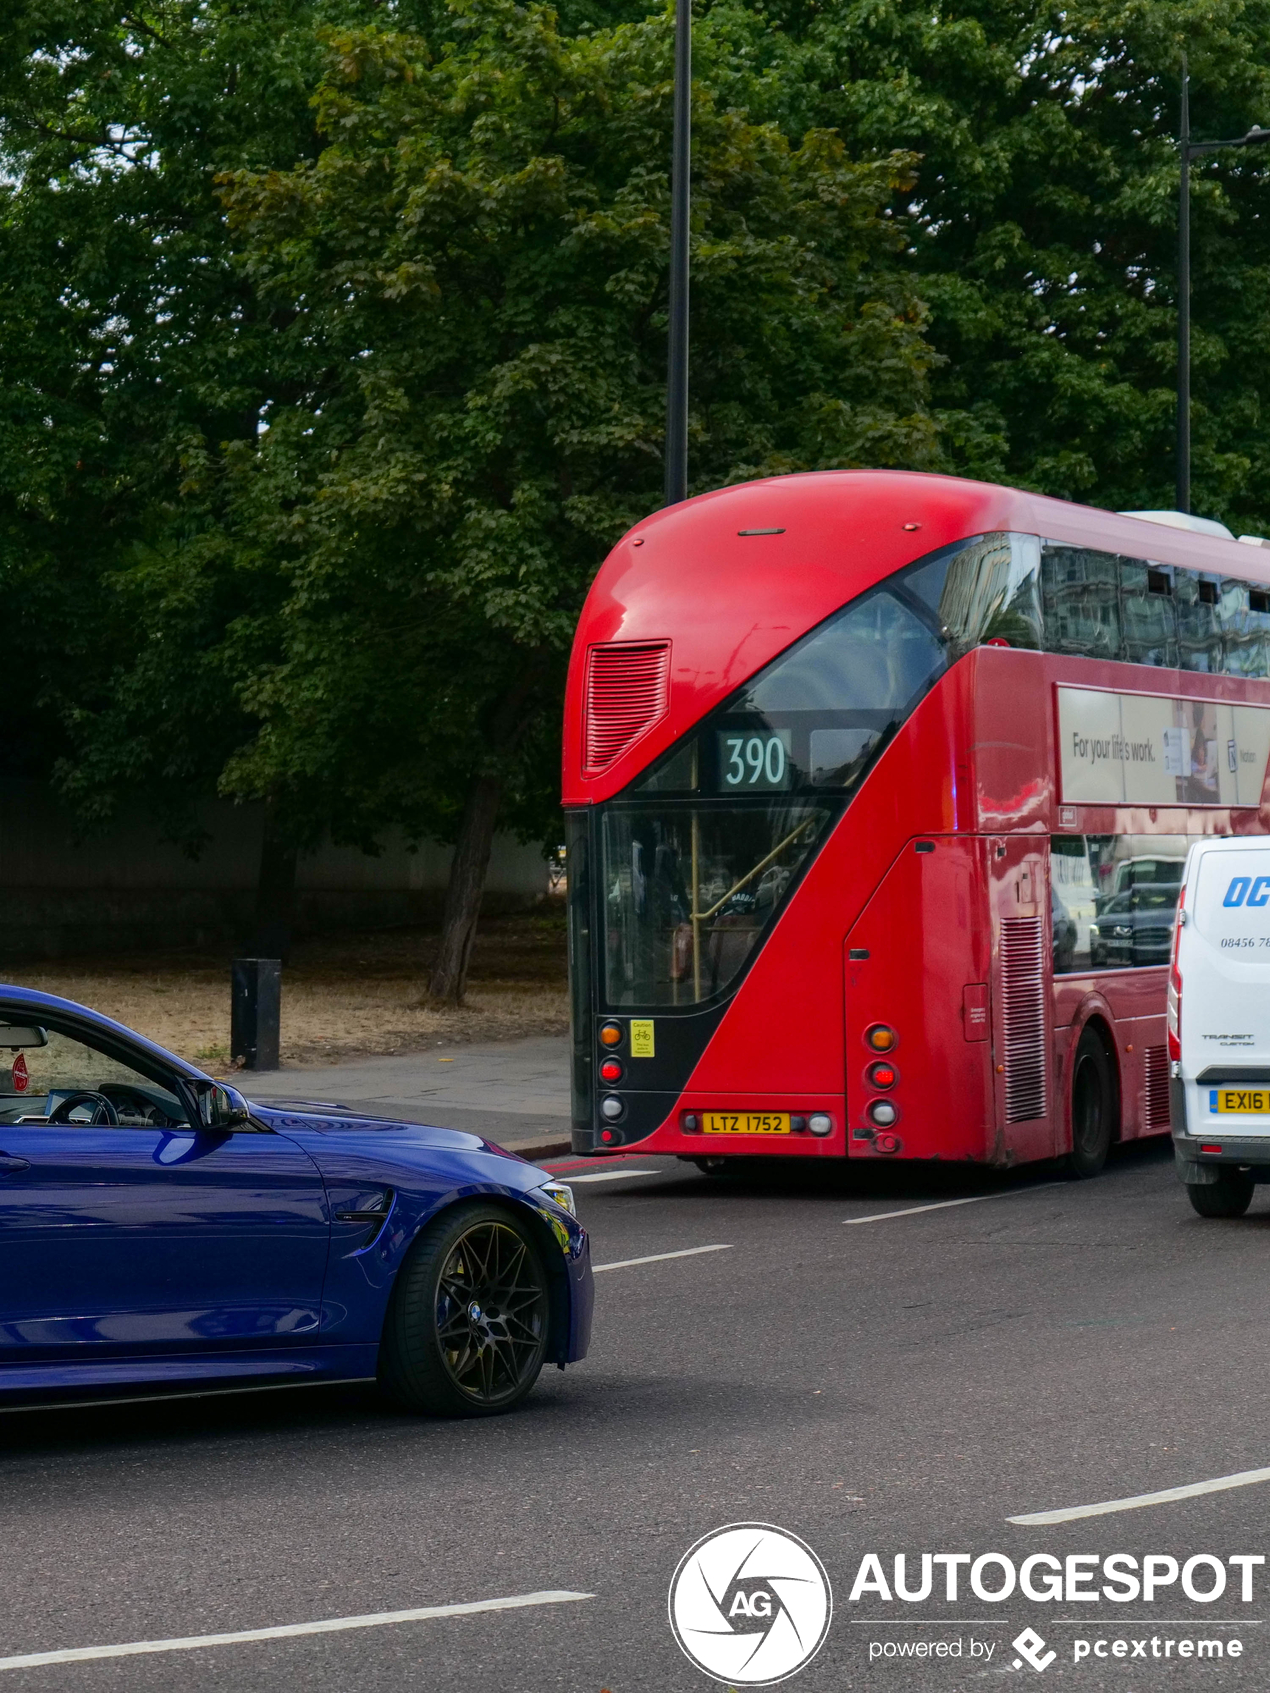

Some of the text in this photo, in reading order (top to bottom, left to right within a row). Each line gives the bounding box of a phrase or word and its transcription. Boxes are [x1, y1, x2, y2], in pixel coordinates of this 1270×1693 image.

[1073, 732, 1089, 757] For
[1090, 739, 1110, 765] your
[1112, 734, 1129, 761] life's
[1131, 738, 1155, 762] work.
[726, 736, 785, 785] 390
[1221, 938, 1254, 948] 08456
[1226, 1092, 1263, 1109] EX16
[711, 1116, 782, 1131] LTZ 1752
